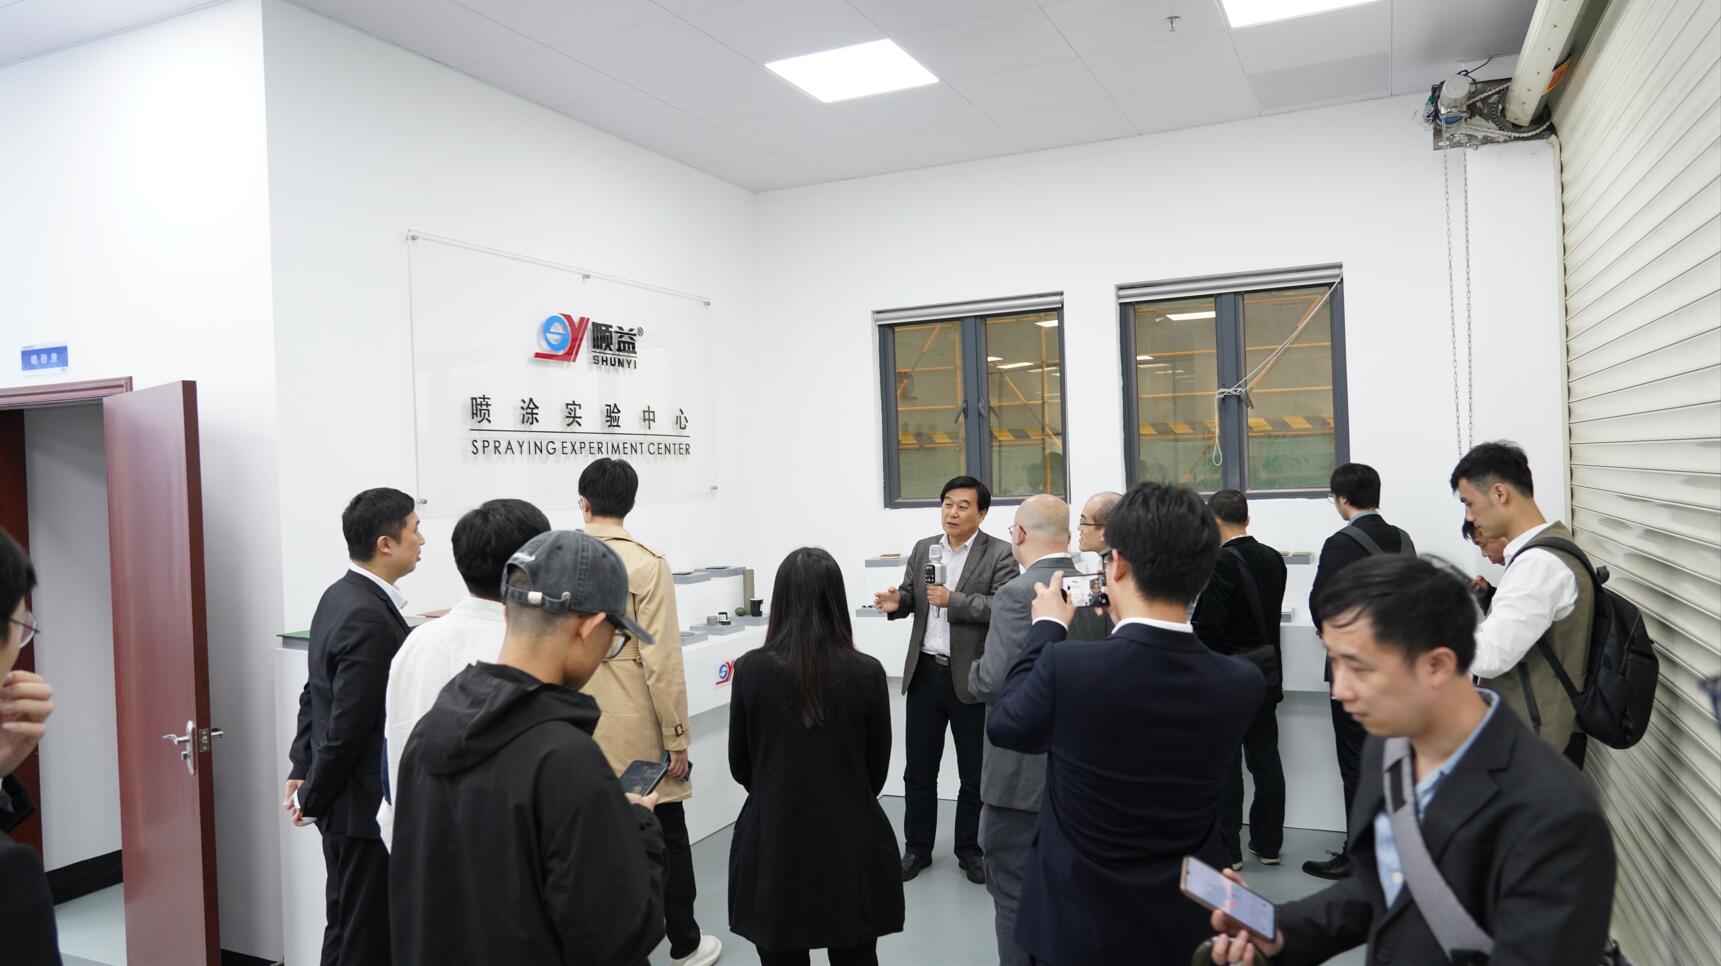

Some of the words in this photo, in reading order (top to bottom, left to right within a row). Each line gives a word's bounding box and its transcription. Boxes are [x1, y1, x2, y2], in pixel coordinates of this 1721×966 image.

[591, 321, 637, 353] 顺益
[593, 355, 637, 369] SHUNYI
[470, 395, 689, 430] 喷涂实验中心
[471, 439, 557, 455] SPRAYING
[561, 441, 644, 455] EXPERIMENT
[647, 442, 691, 456] CENTER
